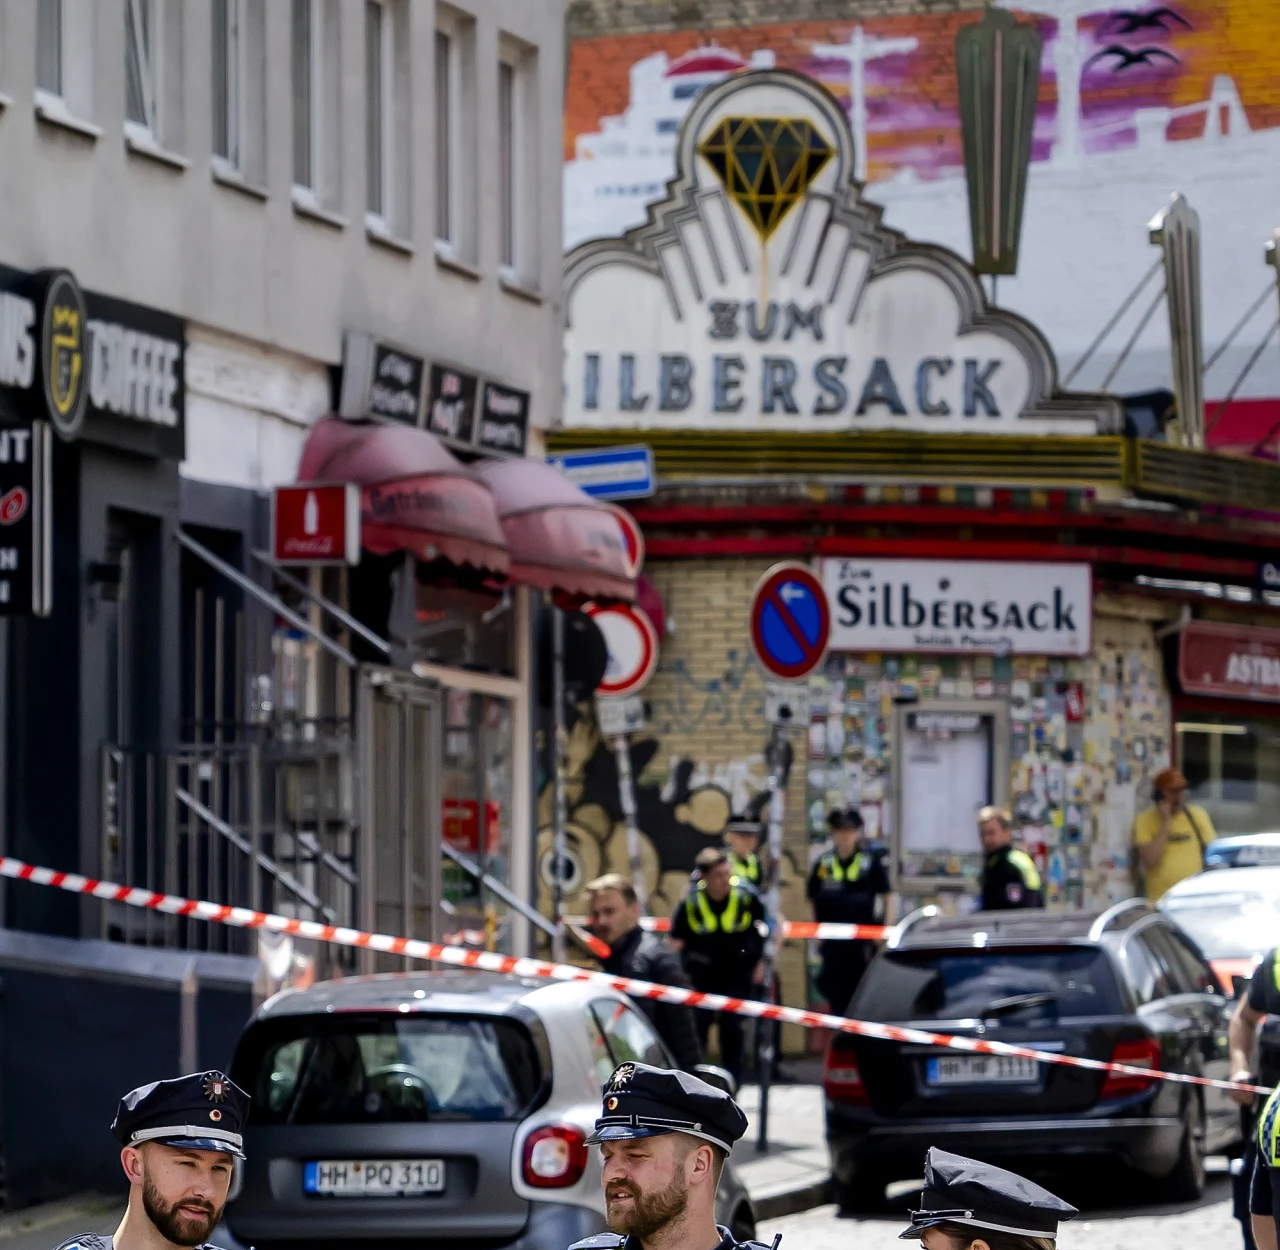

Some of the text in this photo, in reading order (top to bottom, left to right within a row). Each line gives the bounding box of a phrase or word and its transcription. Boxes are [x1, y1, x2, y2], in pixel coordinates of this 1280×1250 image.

[707, 300, 825, 343] ZUM
[581, 352, 1002, 418] ILBERSACK
[319, 1163, 439, 1186] HH PQ 310
